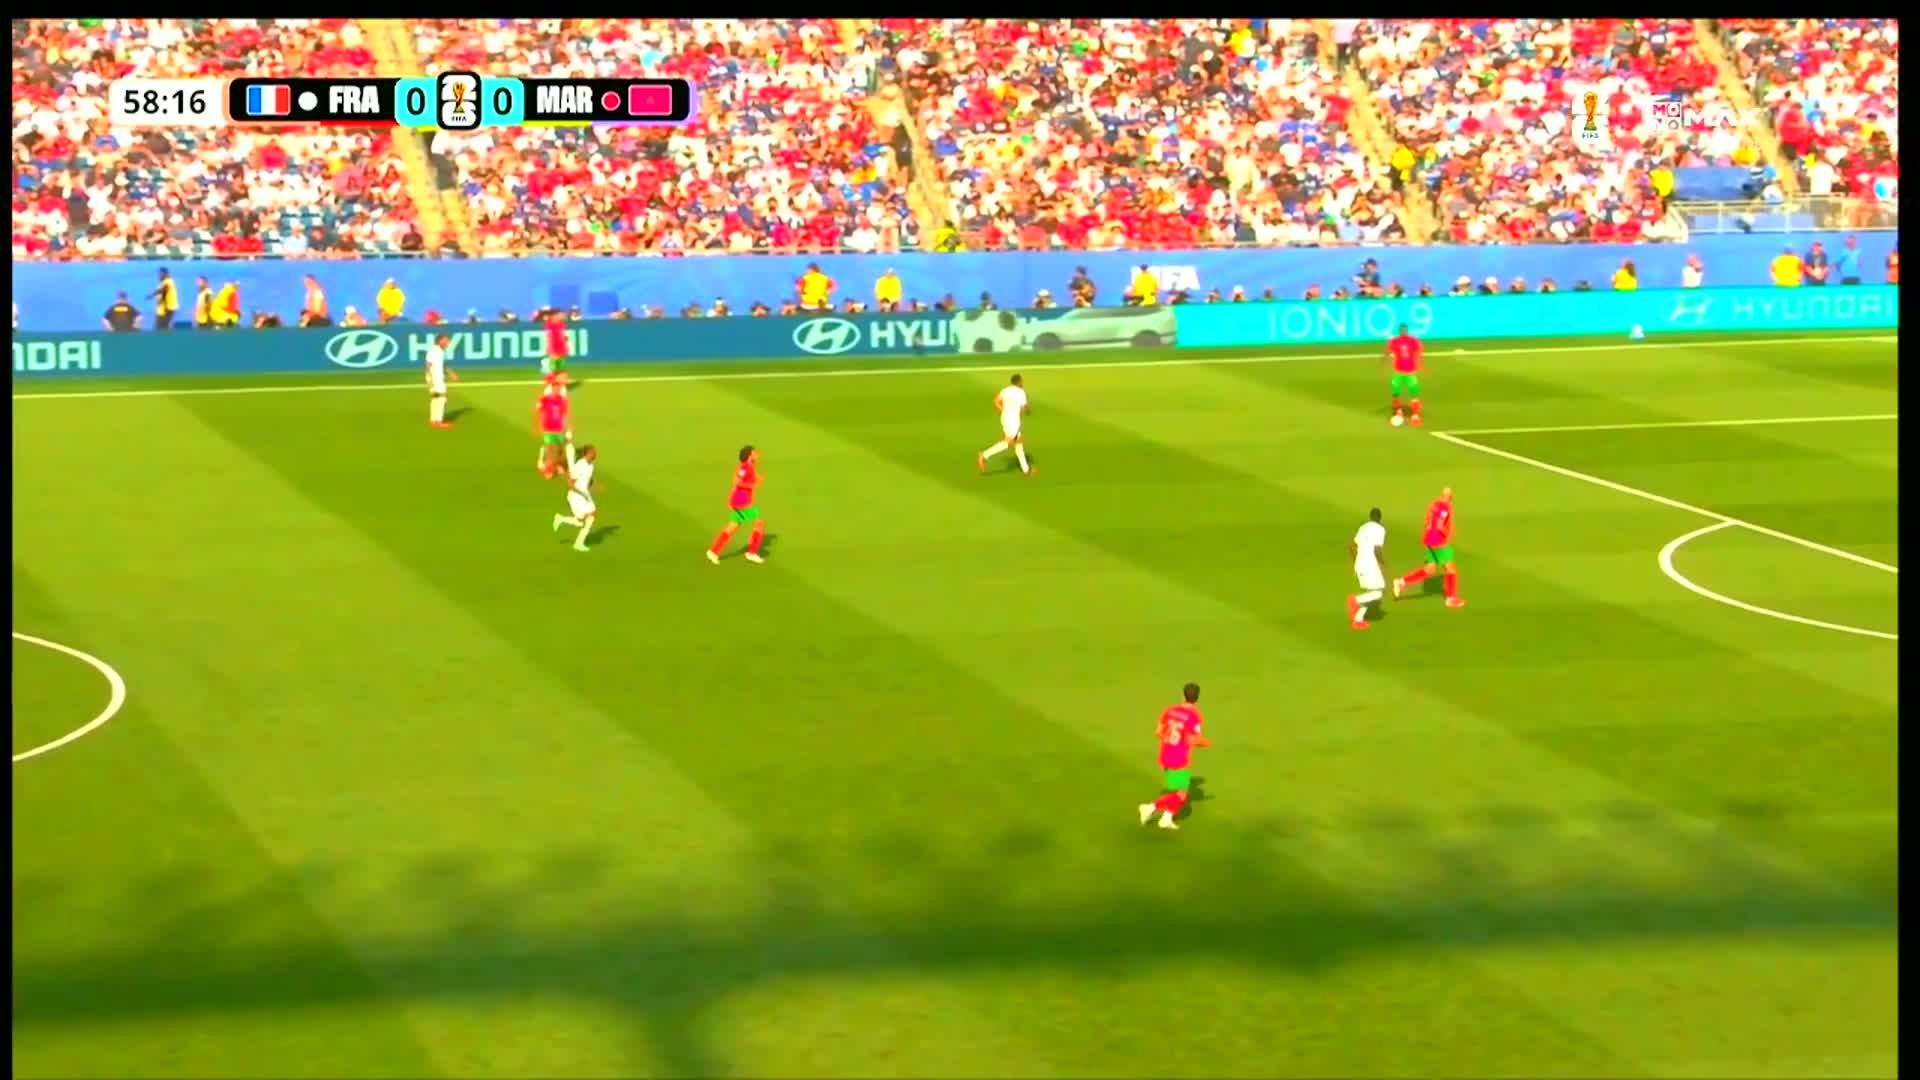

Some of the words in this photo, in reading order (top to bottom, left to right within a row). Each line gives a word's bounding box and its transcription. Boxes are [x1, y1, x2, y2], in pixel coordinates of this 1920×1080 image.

[1268, 303, 1397, 338] IONIQ
[1408, 301, 1433, 336] 9
[1732, 295, 1893, 322] HYUNDAI
